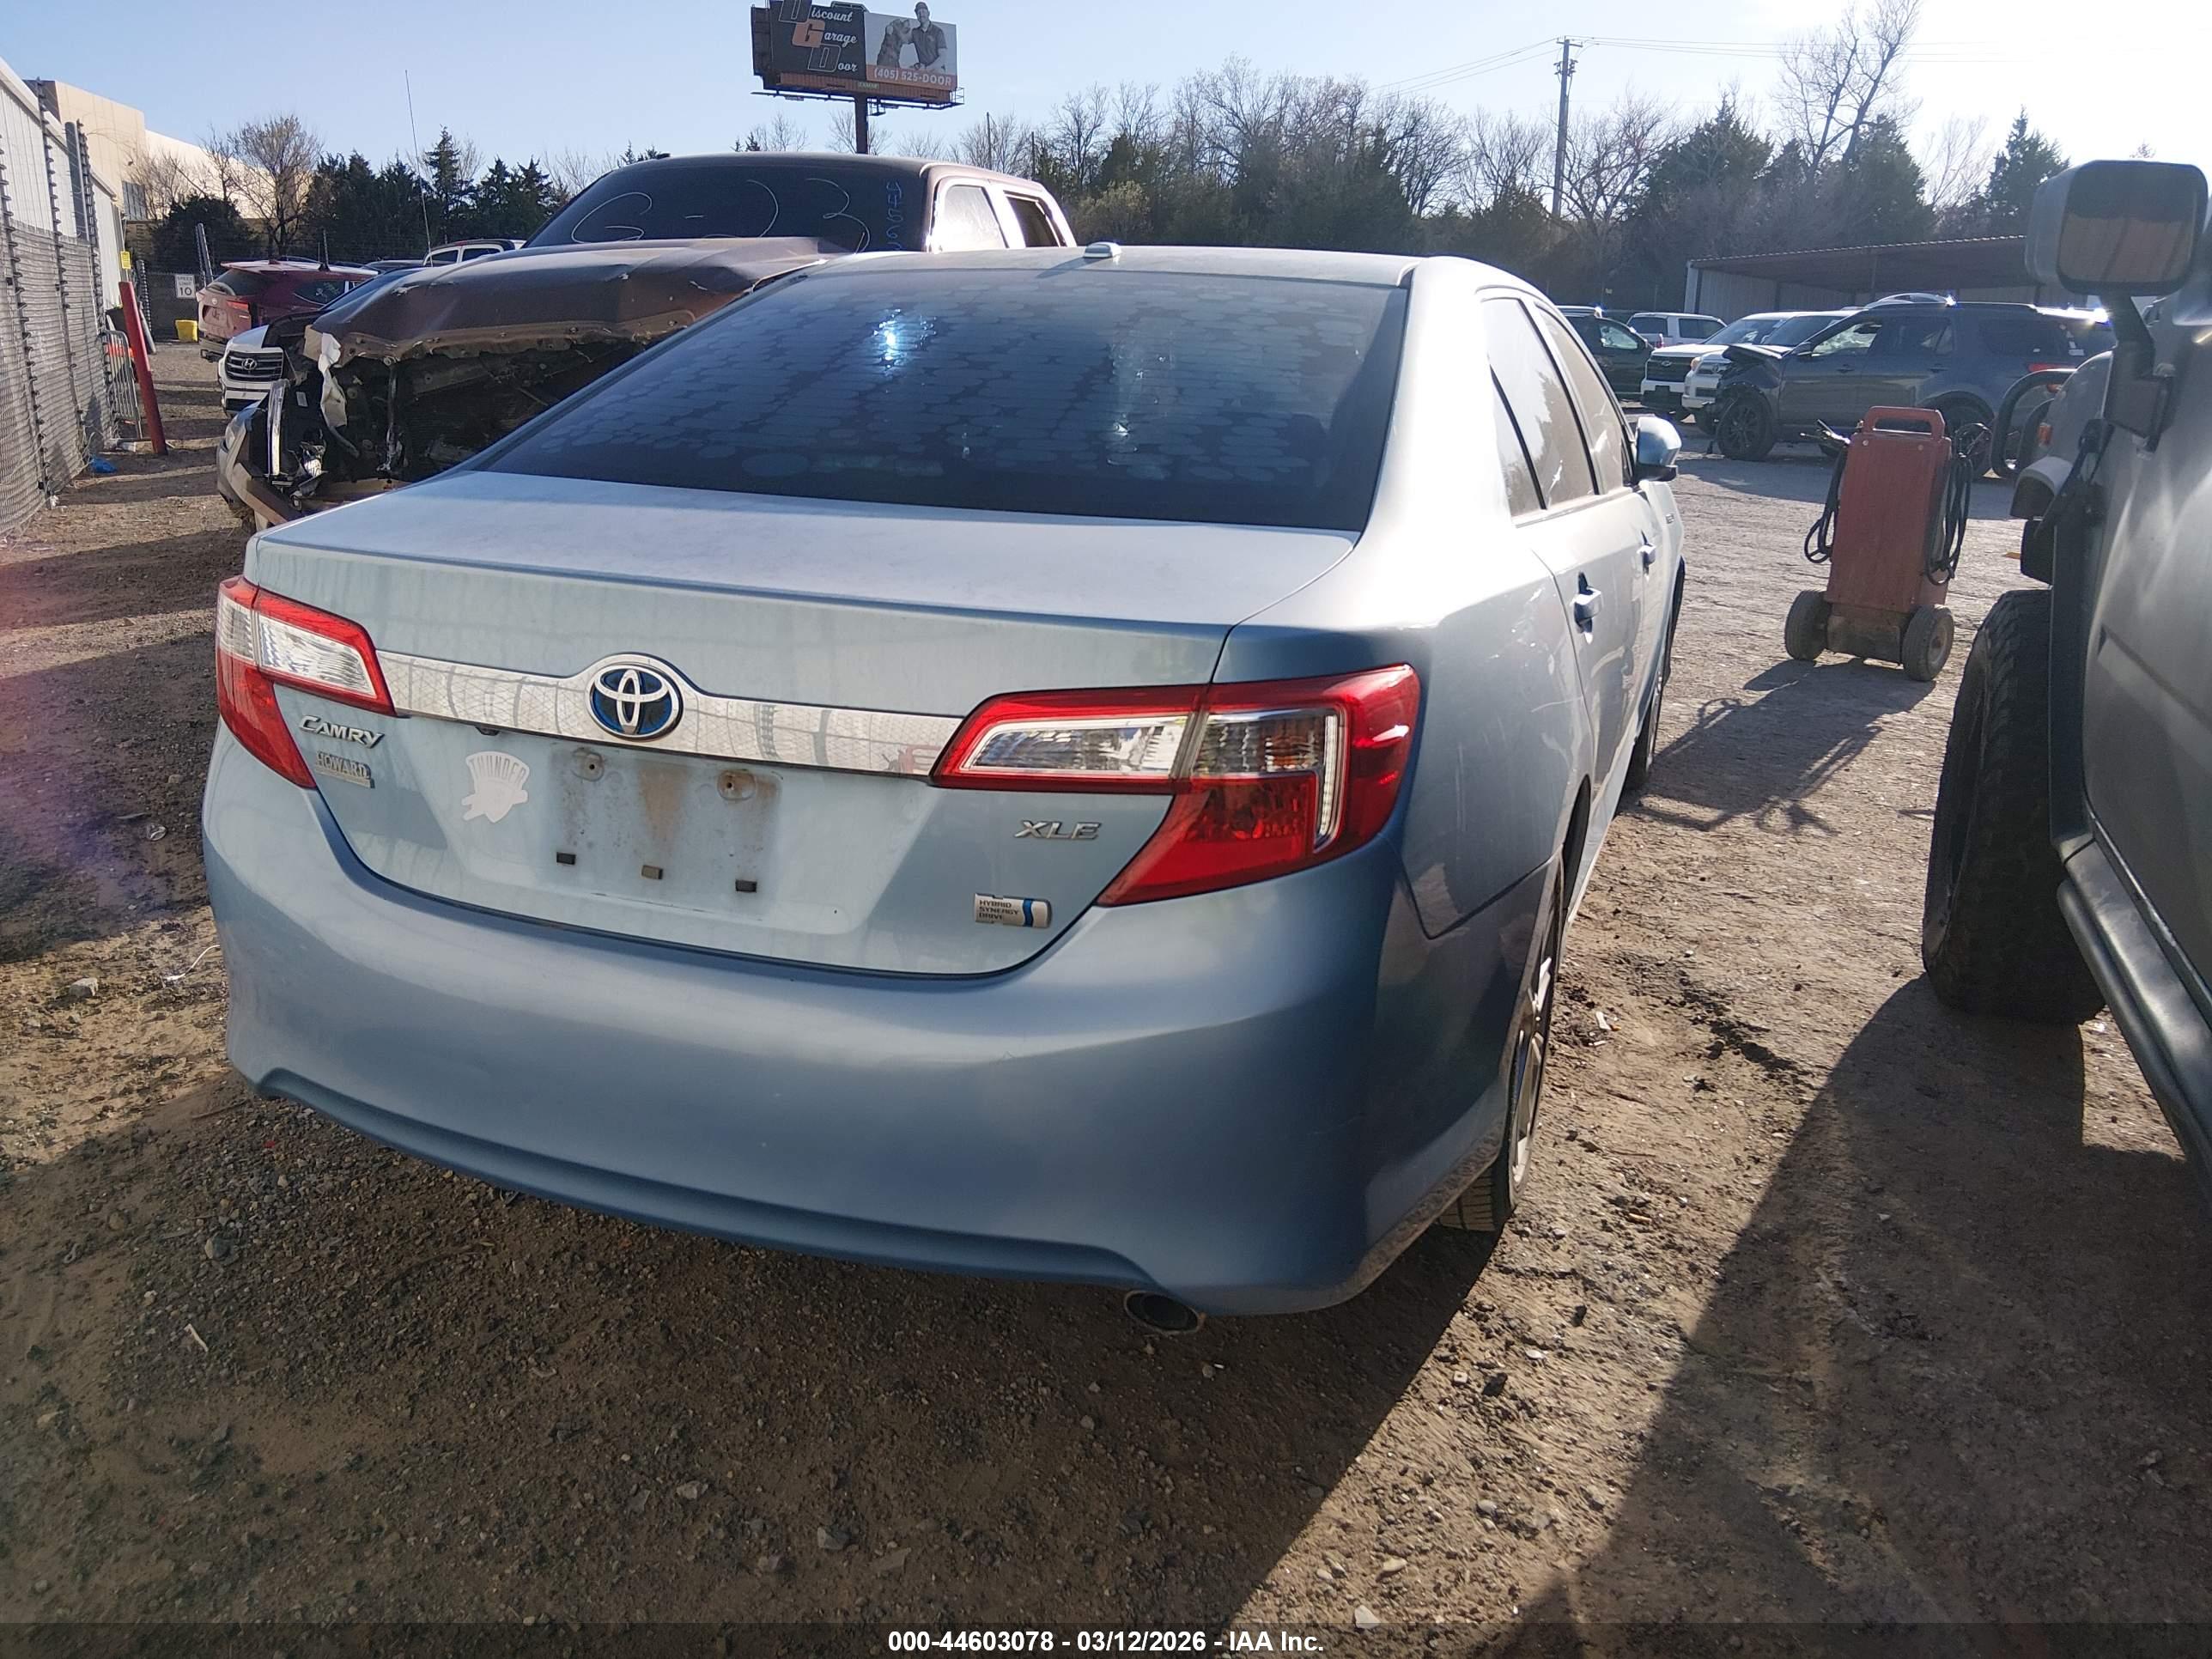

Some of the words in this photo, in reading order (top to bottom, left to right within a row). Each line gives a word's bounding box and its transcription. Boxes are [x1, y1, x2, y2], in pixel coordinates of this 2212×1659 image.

[779, 0, 853, 23] Discount
[792, 19, 857, 48] Garage
[807, 44, 858, 73] Door
[874, 67, 899, 85] (405)
[179, 287, 192, 296] 10
[299, 714, 385, 749] CAMRY
[316, 750, 371, 780] HOWARD
[1014, 820, 1102, 841] XLE
[979, 899, 1012, 908] HYBRID
[979, 906, 1018, 915] SYNERGY
